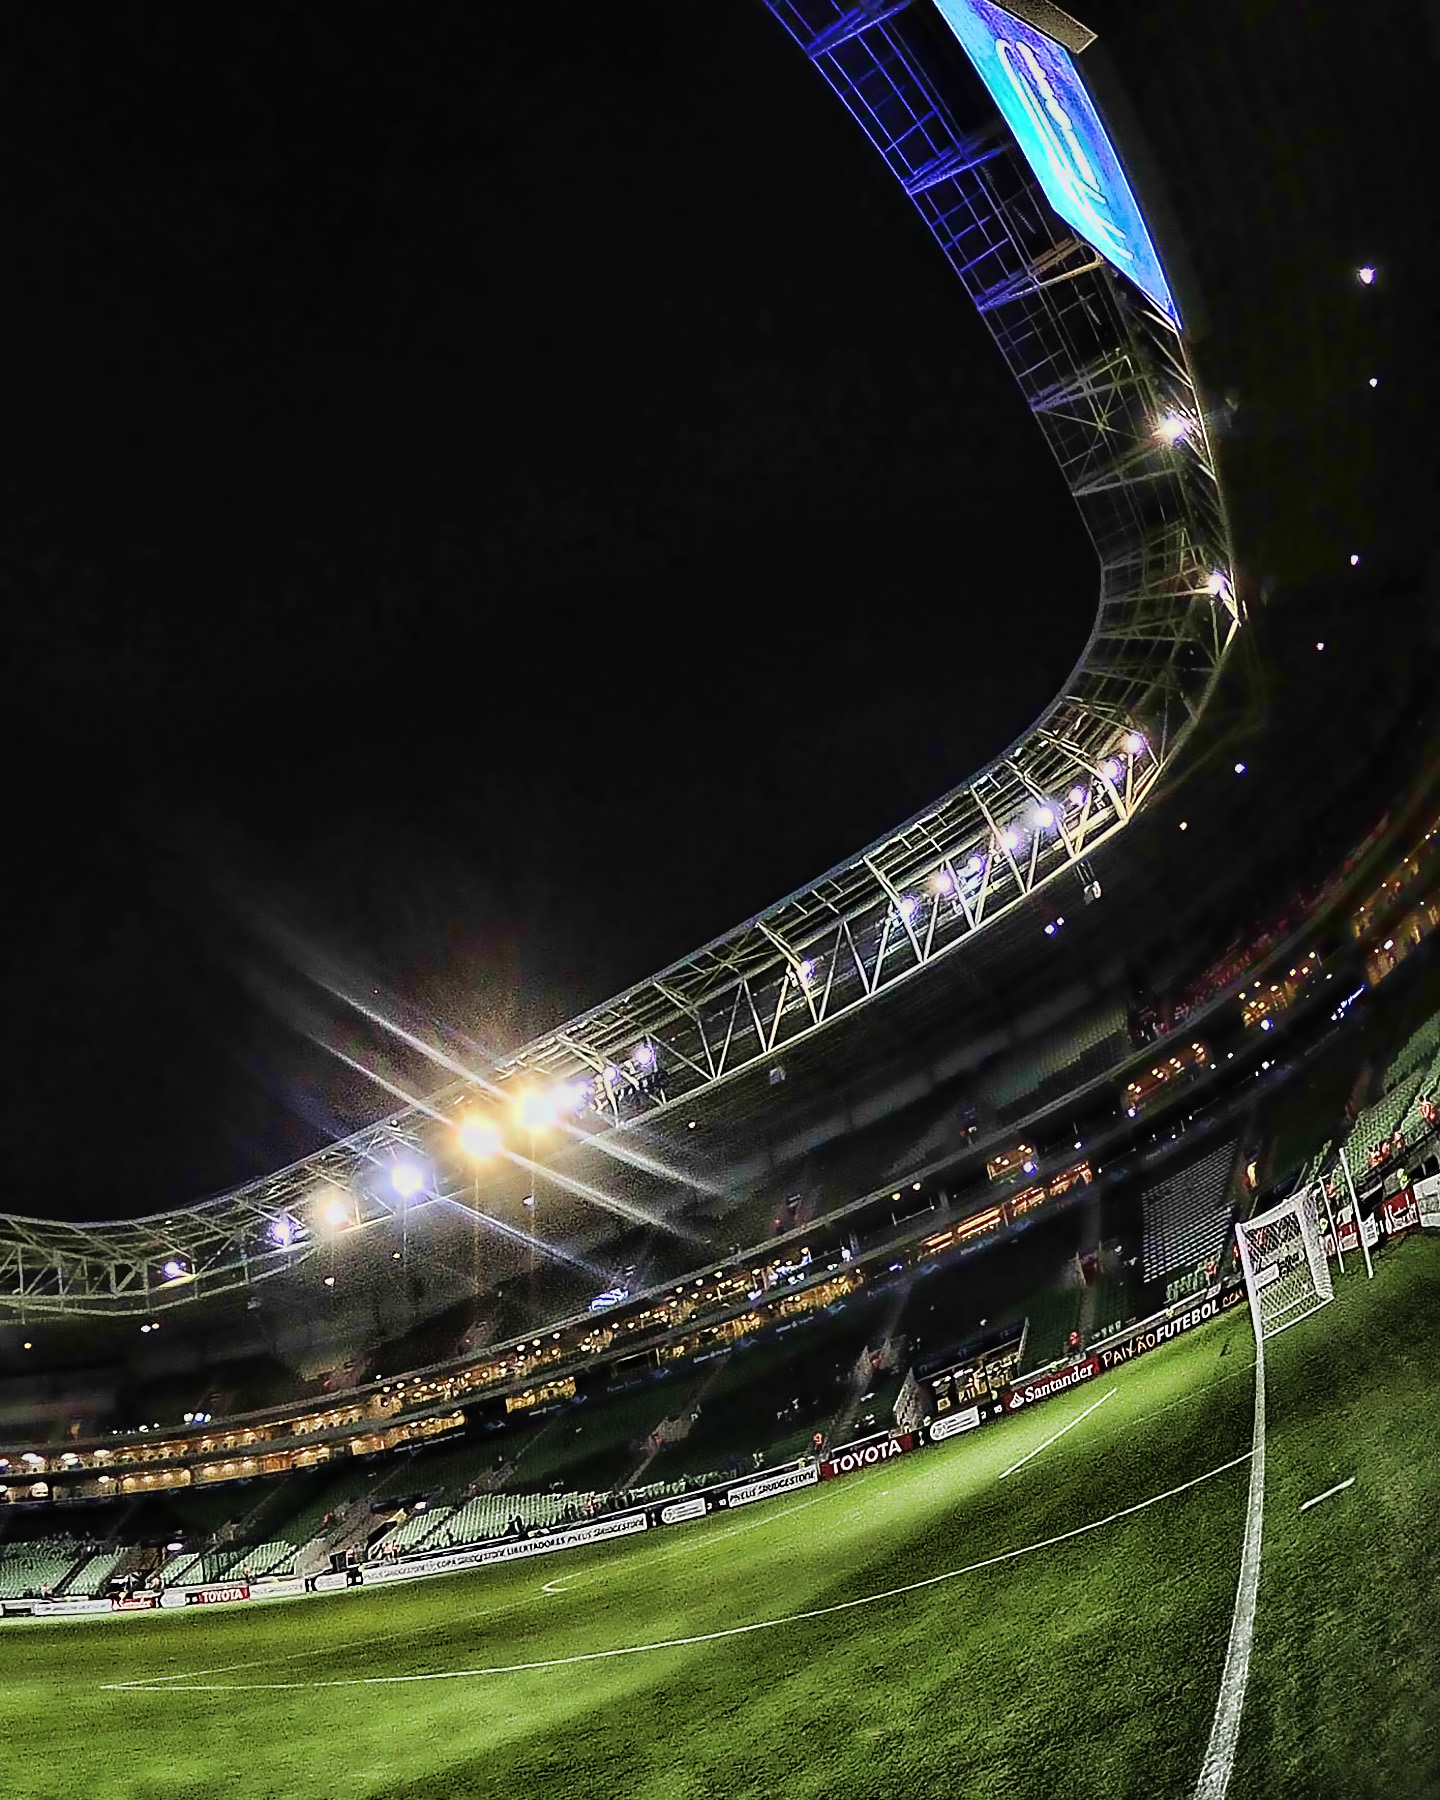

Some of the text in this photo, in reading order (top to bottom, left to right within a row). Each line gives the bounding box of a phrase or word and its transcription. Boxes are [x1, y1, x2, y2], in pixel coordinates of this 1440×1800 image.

[1102, 1333, 1155, 1368] PAIXÃO
[1156, 1299, 1220, 1343] FUTEBOL
[1024, 1363, 1094, 1403] Santander
[829, 1439, 903, 1475] TOYOTA
[201, 1588, 243, 1602] TOYOTA
